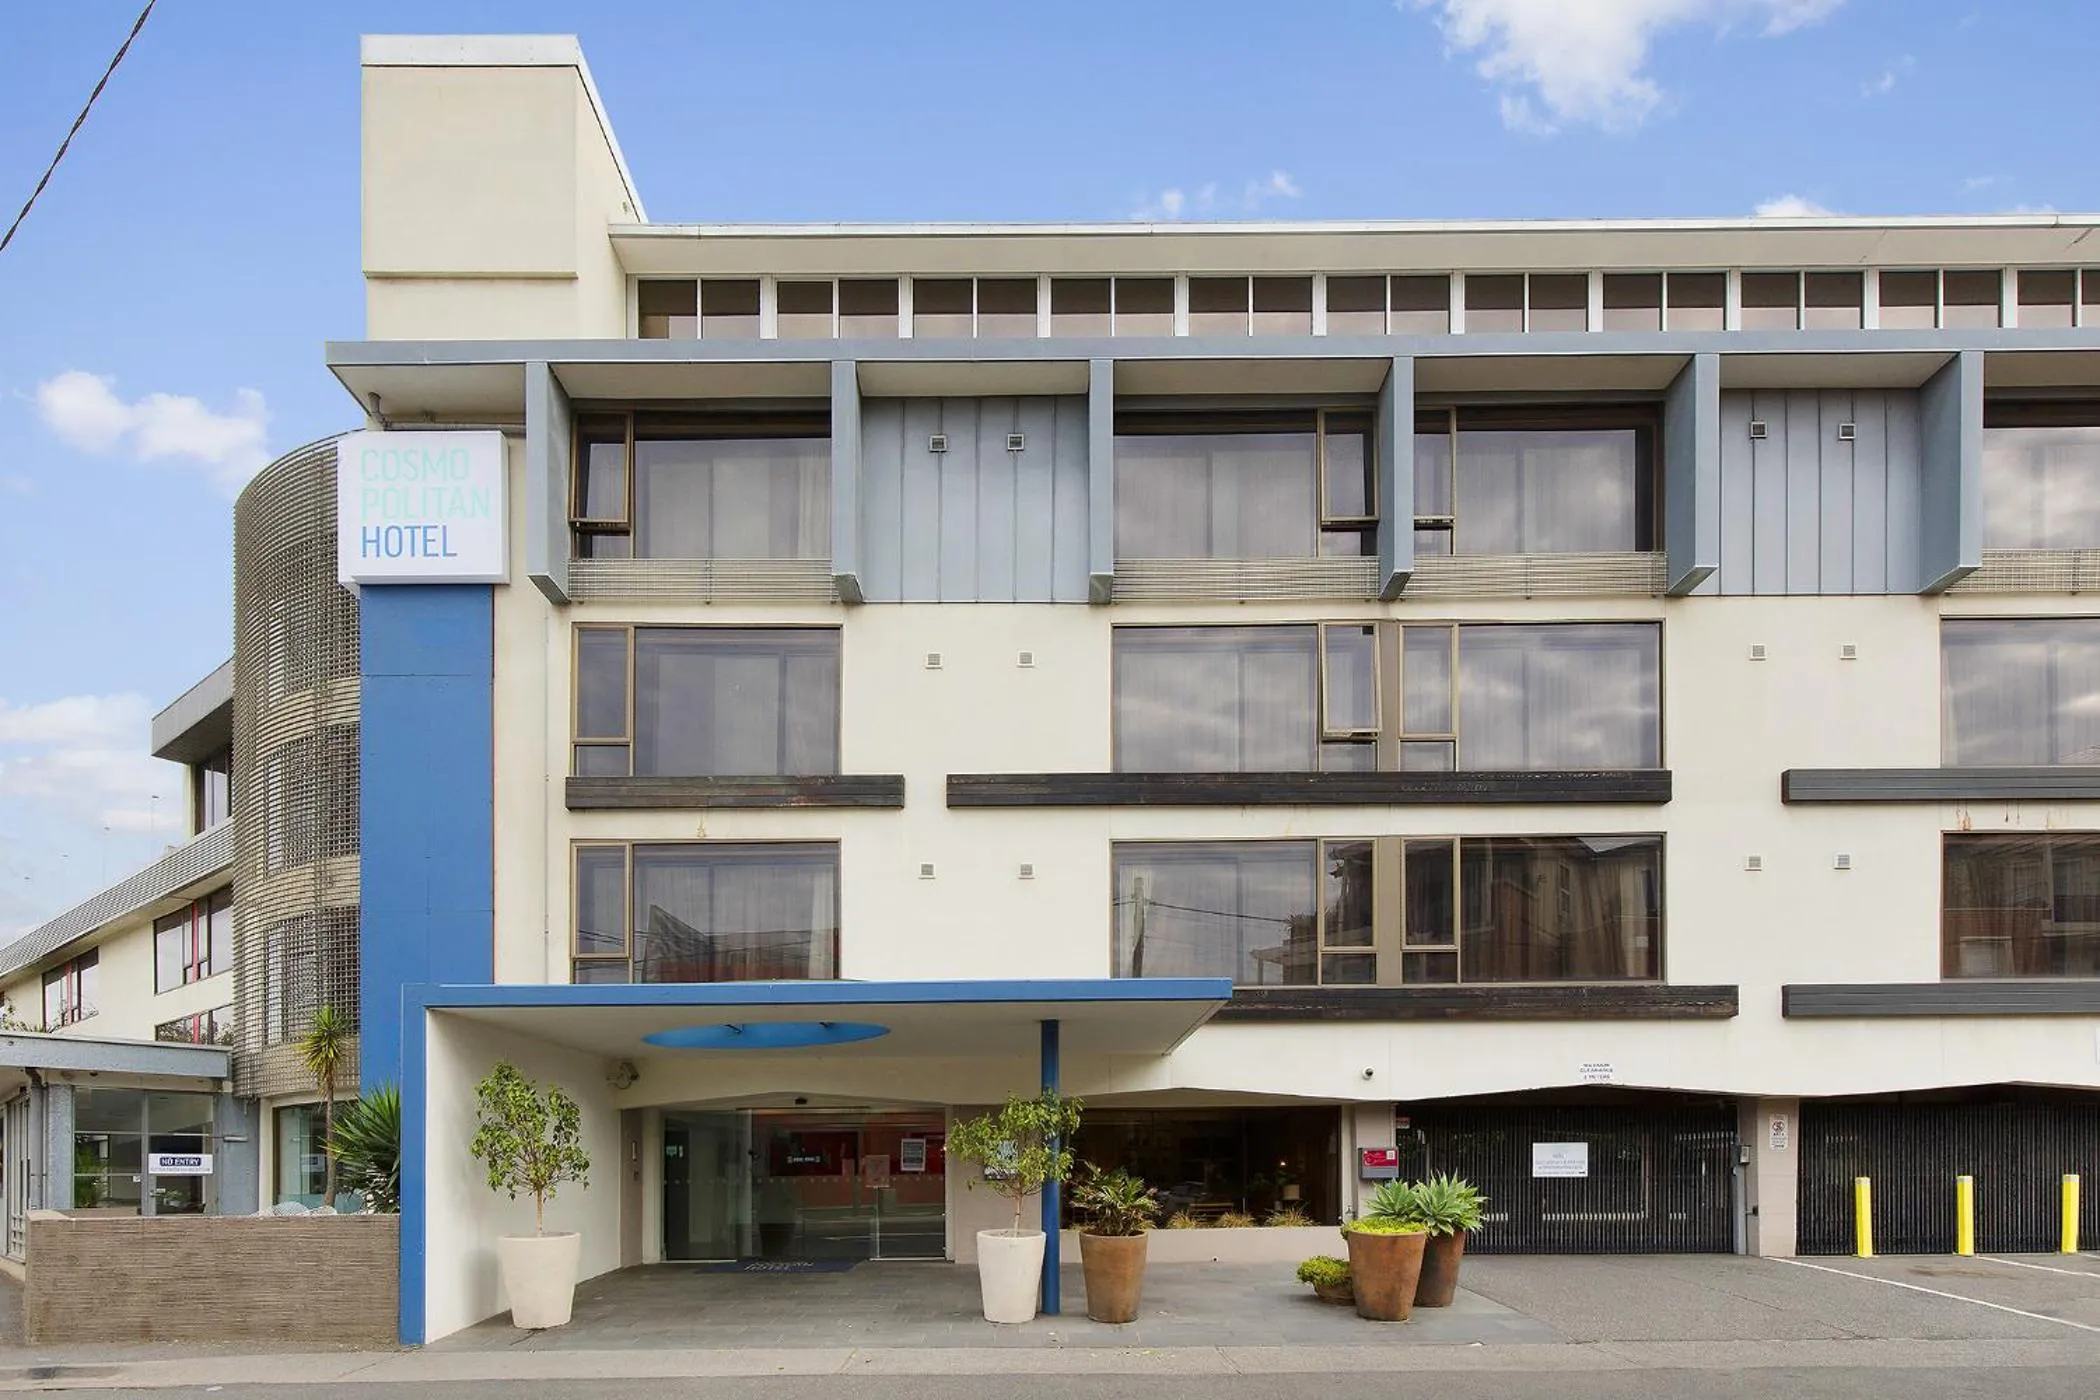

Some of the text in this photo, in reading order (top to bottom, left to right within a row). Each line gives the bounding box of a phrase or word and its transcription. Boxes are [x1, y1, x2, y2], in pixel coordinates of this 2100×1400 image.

[360, 448, 470, 482] COSMO
[361, 486, 491, 520] POLITAN
[361, 524, 458, 558] HOTEL
[162, 1158, 199, 1166] NO ENTRY
